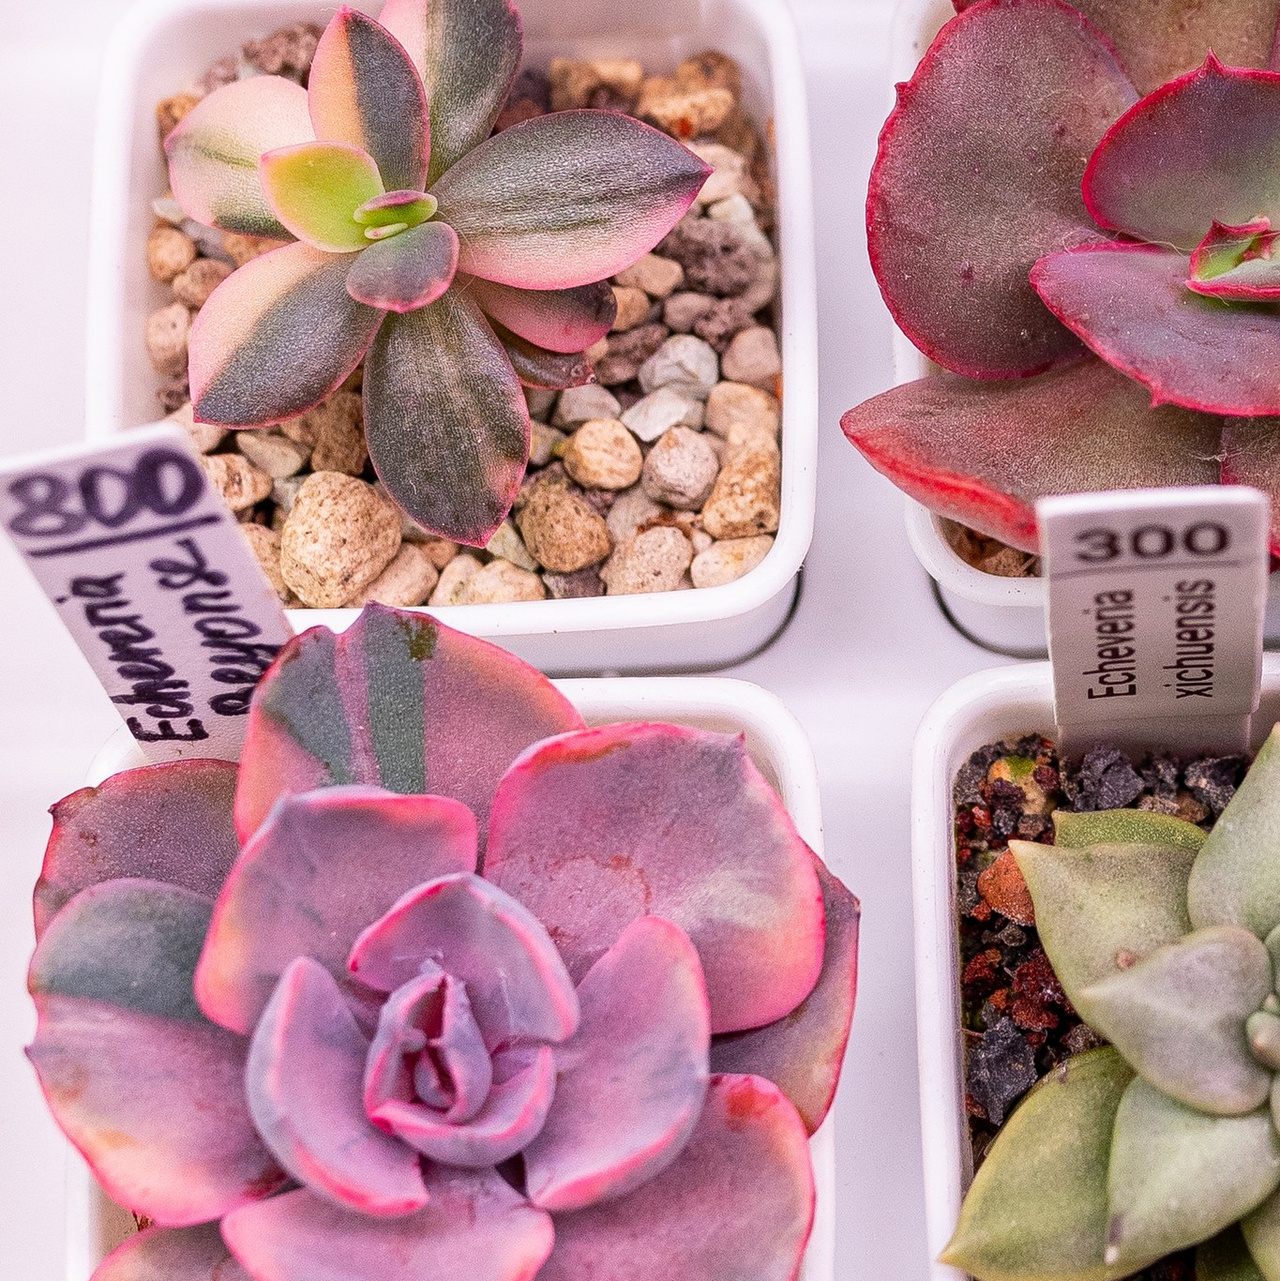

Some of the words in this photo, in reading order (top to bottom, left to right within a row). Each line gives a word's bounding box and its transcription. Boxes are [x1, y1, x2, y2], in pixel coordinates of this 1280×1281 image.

[8, 447, 205, 537] 800
[1073, 520, 1230, 563] 300
[1082, 588, 1136, 699] Echeveria
[1162, 578, 1215, 699] xichuensis
